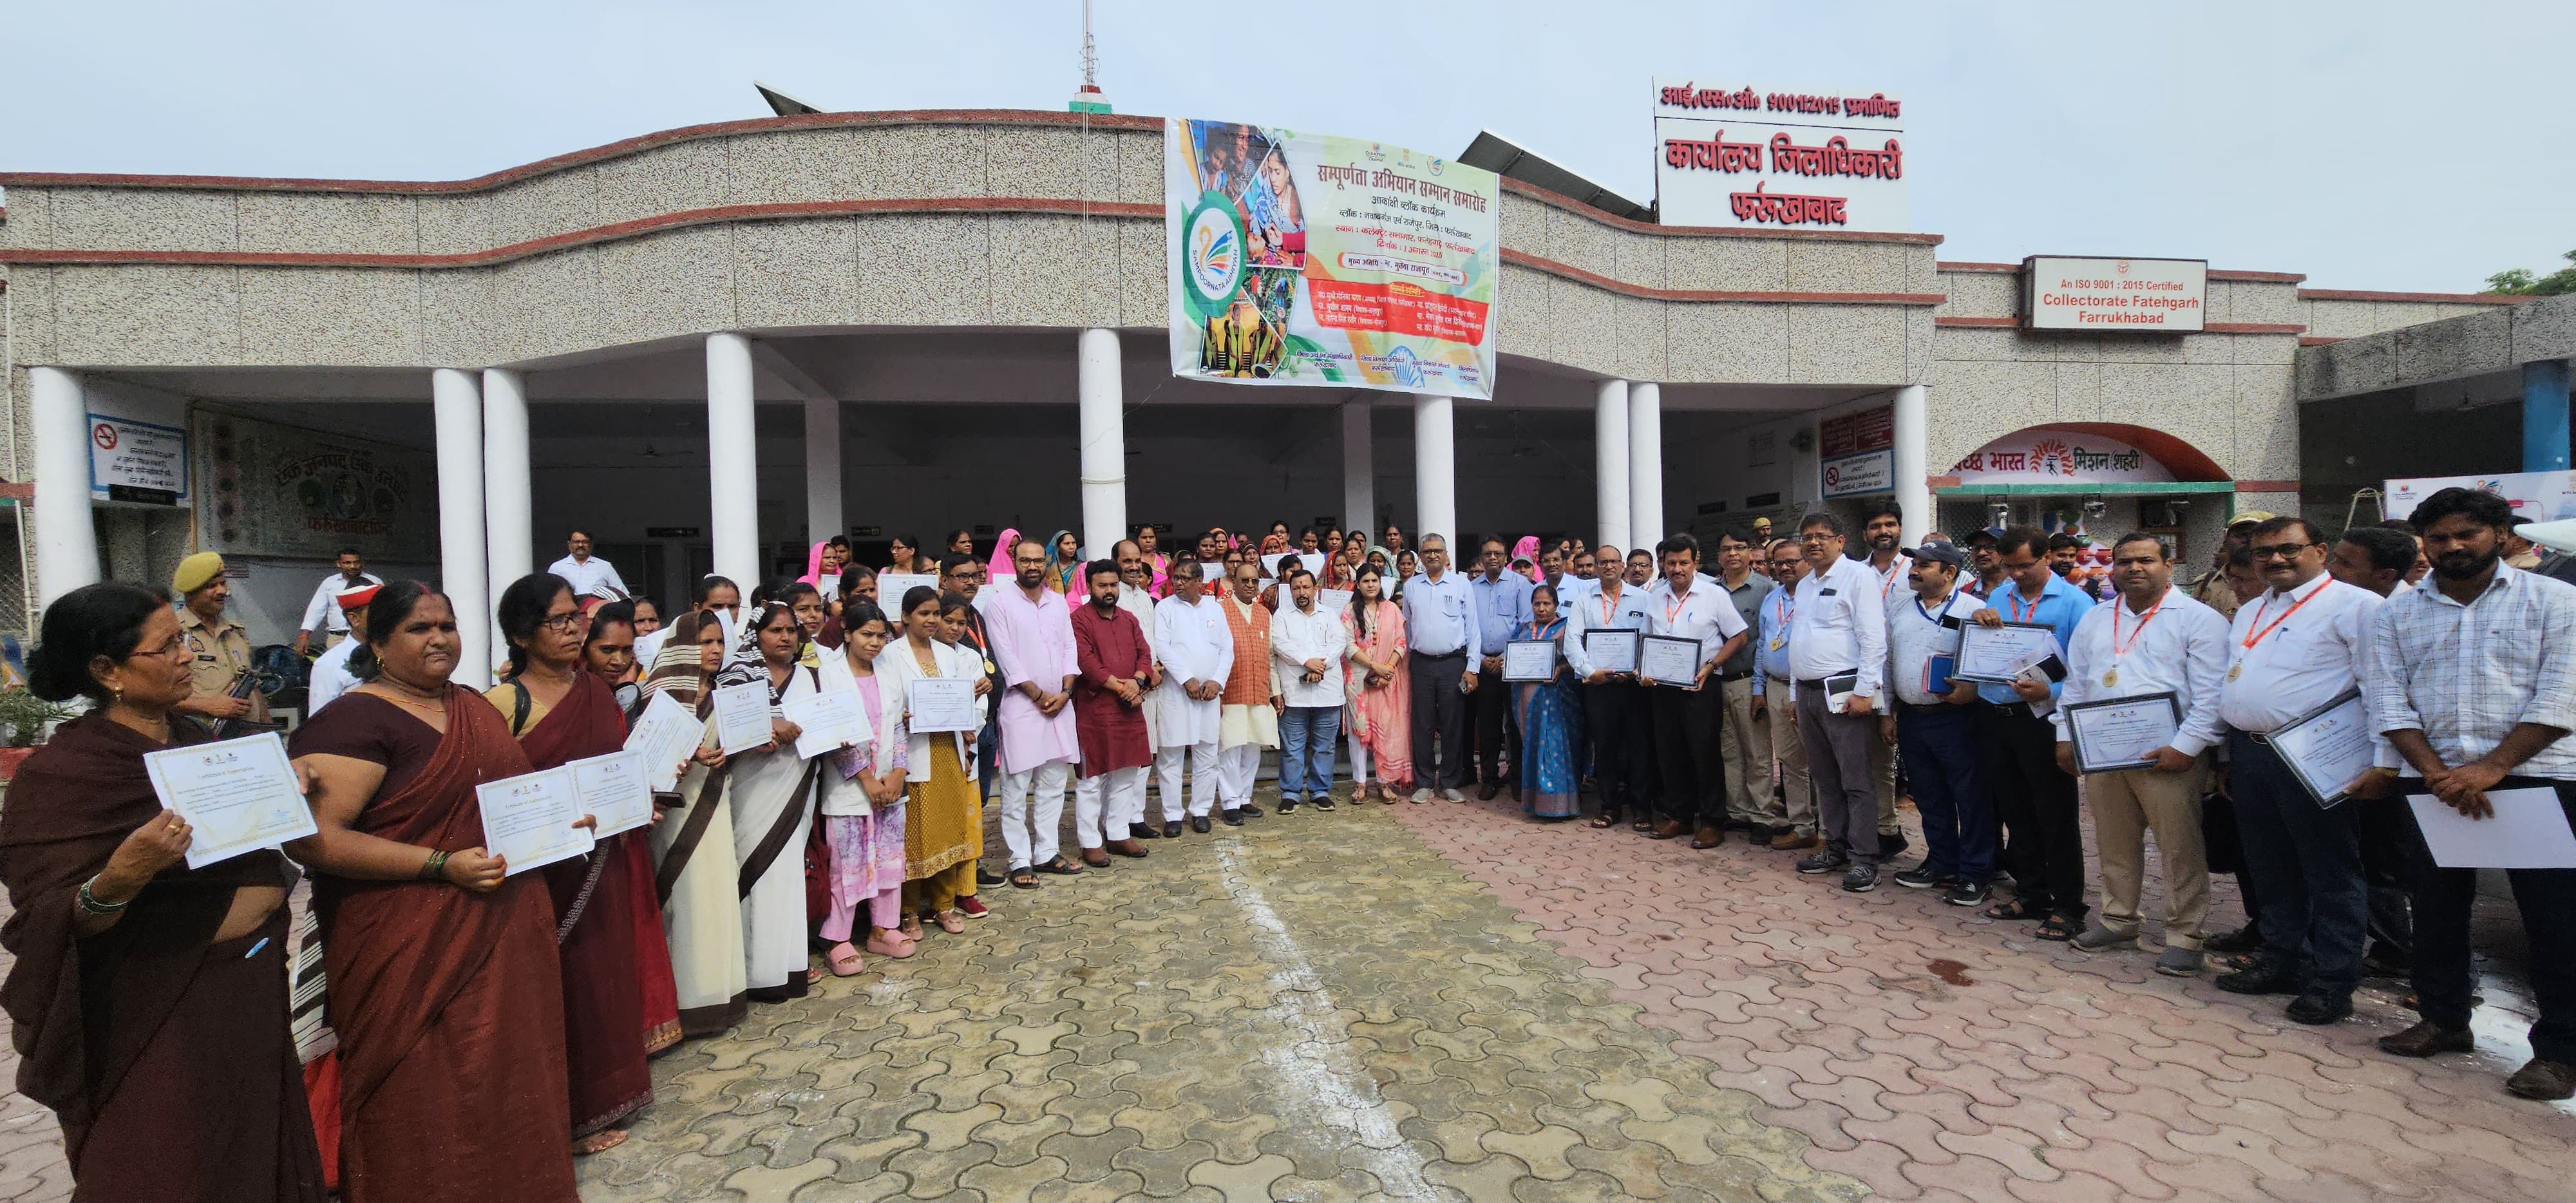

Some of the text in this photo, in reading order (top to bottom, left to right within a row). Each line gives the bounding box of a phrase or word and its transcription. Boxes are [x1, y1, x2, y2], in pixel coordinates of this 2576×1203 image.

[1768, 93, 1841, 113] 9001:2015
[1844, 93, 1901, 118] प्रमाणित
[1665, 129, 1902, 179] कार्यालय जिलाधिकारी
[1317, 162, 1486, 213] सम्पूर्णता अभियान सम्मान समारोह
[2061, 279, 2072, 288] An
[2076, 279, 2090, 289] ISO
[2094, 279, 2114, 289] 9001
[2123, 280, 2143, 289] 2015
[2146, 281, 2183, 290] Certified
[2043, 294, 2199, 311] Collectorate Fatehgarh
[2079, 311, 2164, 324] Farrukhabad
[1989, 452, 2025, 471] भारत
[2074, 446, 2143, 471] मिशन (शहरी)
